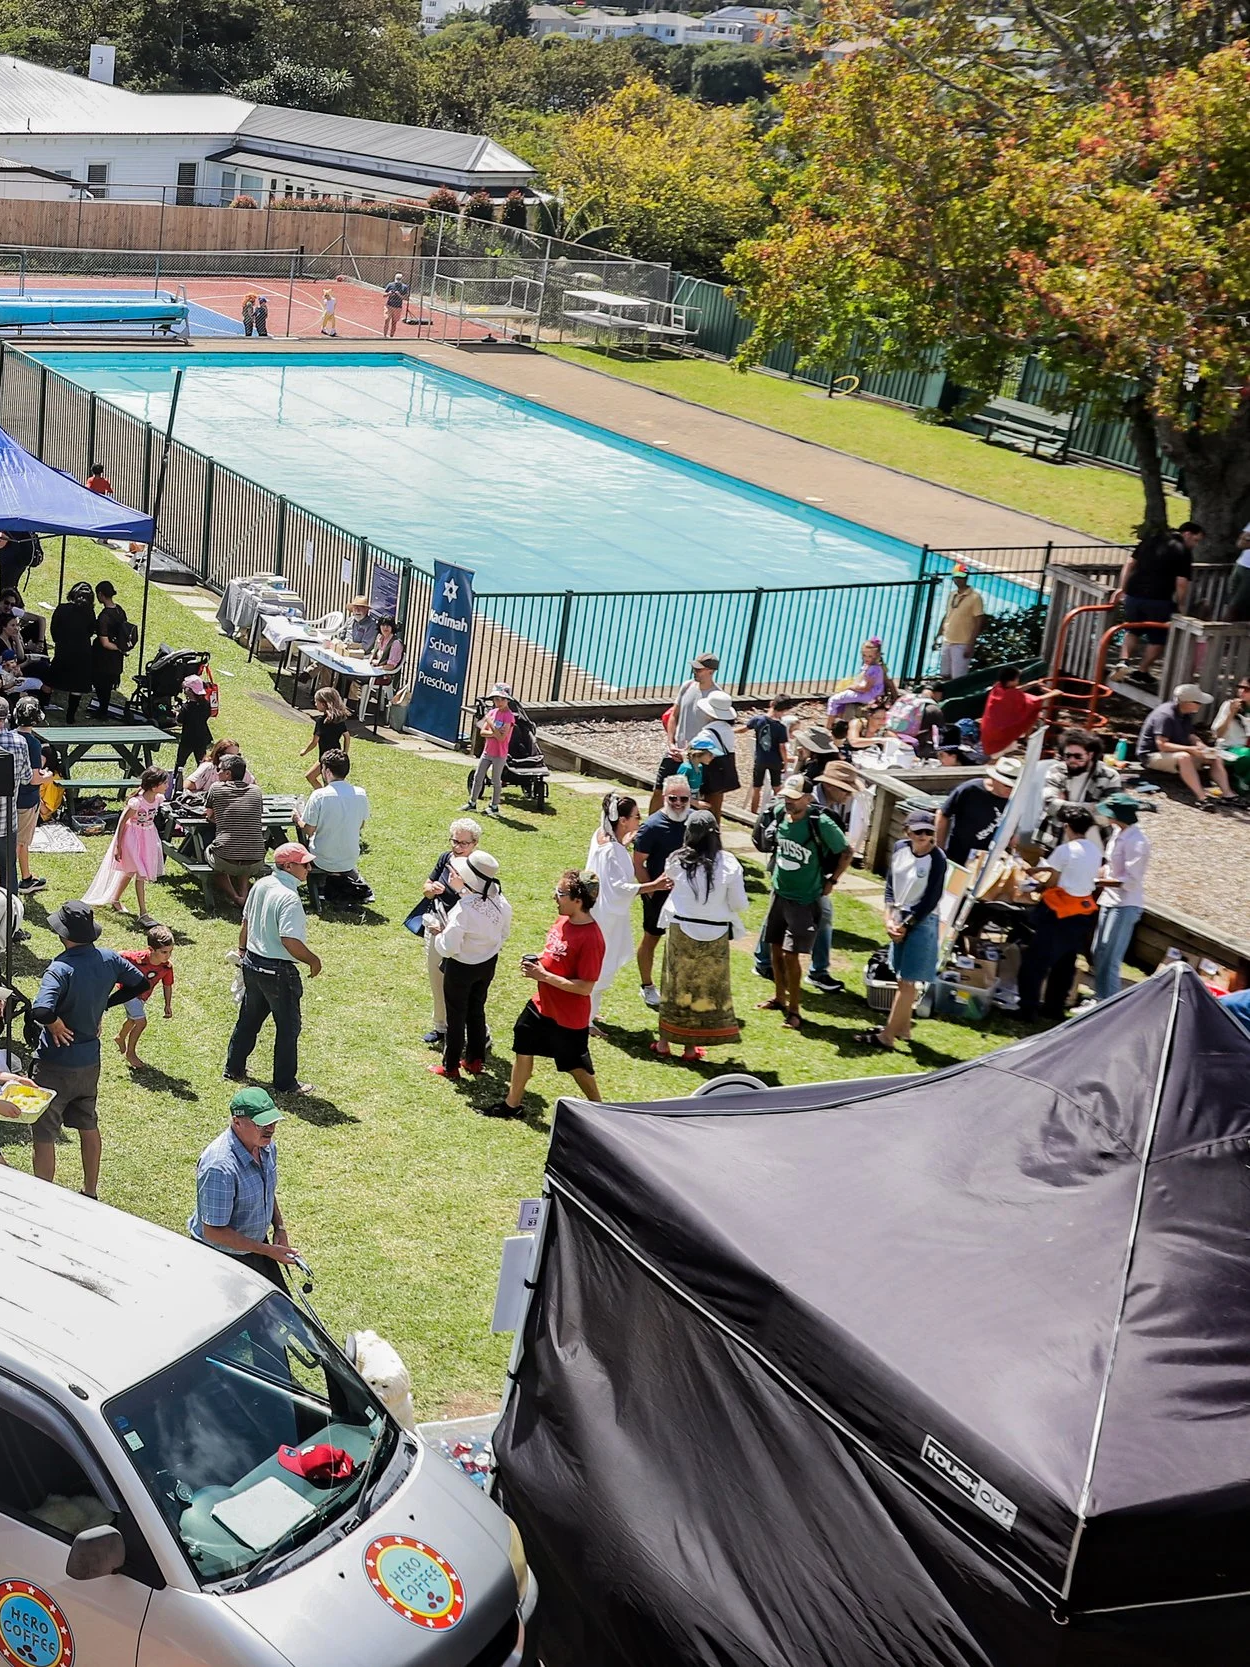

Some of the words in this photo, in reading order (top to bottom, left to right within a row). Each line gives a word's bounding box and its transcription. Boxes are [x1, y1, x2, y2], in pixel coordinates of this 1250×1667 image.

[429, 636, 458, 657] School
[432, 659, 450, 673] and
[418, 669, 459, 695] Preschool
[926, 1444, 979, 1495] TOUGH
[980, 1489, 1014, 1521] OUT
[390, 1557, 421, 1585] HERO
[400, 1565, 442, 1602] COFFEE
[11, 1606, 49, 1634] HERO
[3, 1620, 56, 1656] COFFEE
